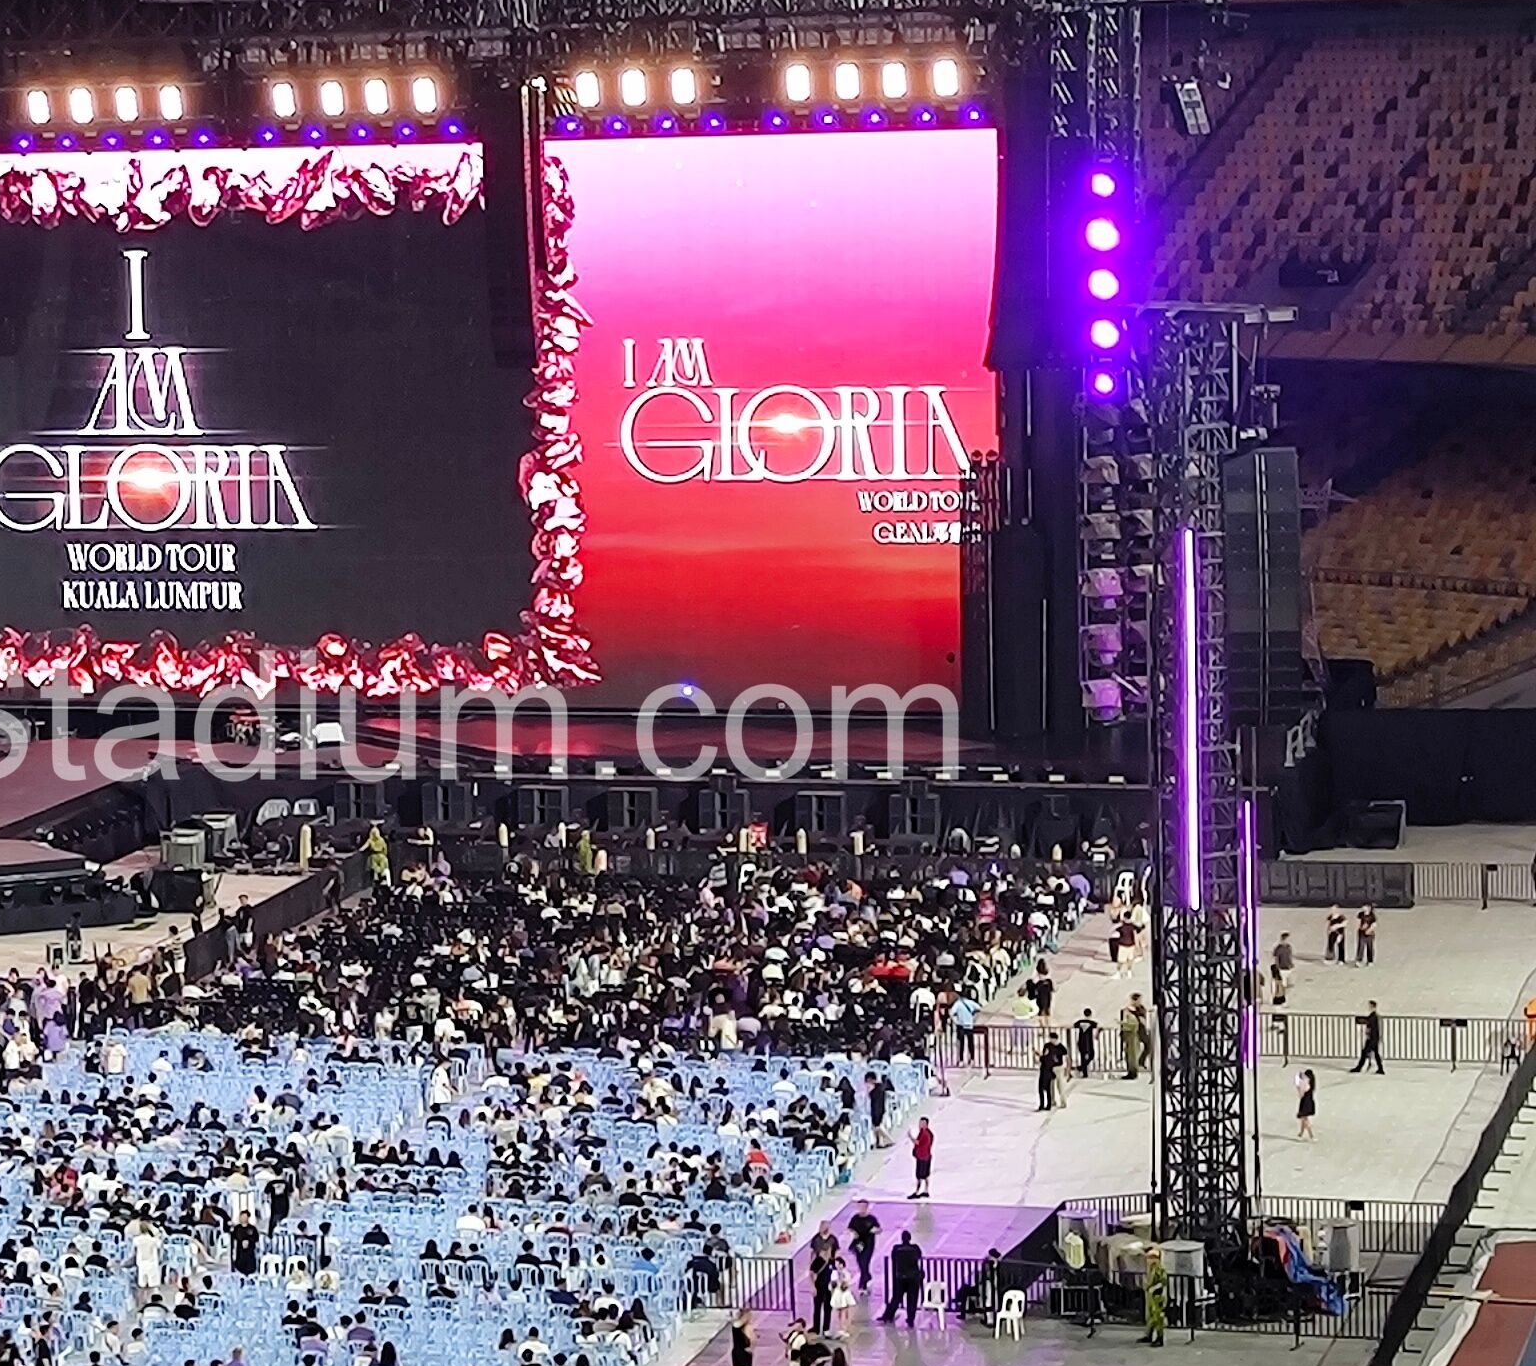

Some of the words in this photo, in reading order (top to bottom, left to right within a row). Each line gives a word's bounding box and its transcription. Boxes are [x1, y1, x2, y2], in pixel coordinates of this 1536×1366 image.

[122, 248, 150, 340] I
[621, 337, 637, 388] I
[646, 337, 713, 387] AM
[79, 346, 205, 436] AM
[620, 385, 977, 483] GLORIA
[857, 490, 928, 512] WORLD
[66, 542, 162, 572] WORLD
[165, 542, 236, 572] TOUR
[62, 580, 139, 610] KUALA
[144, 580, 243, 610] LUMPUR
